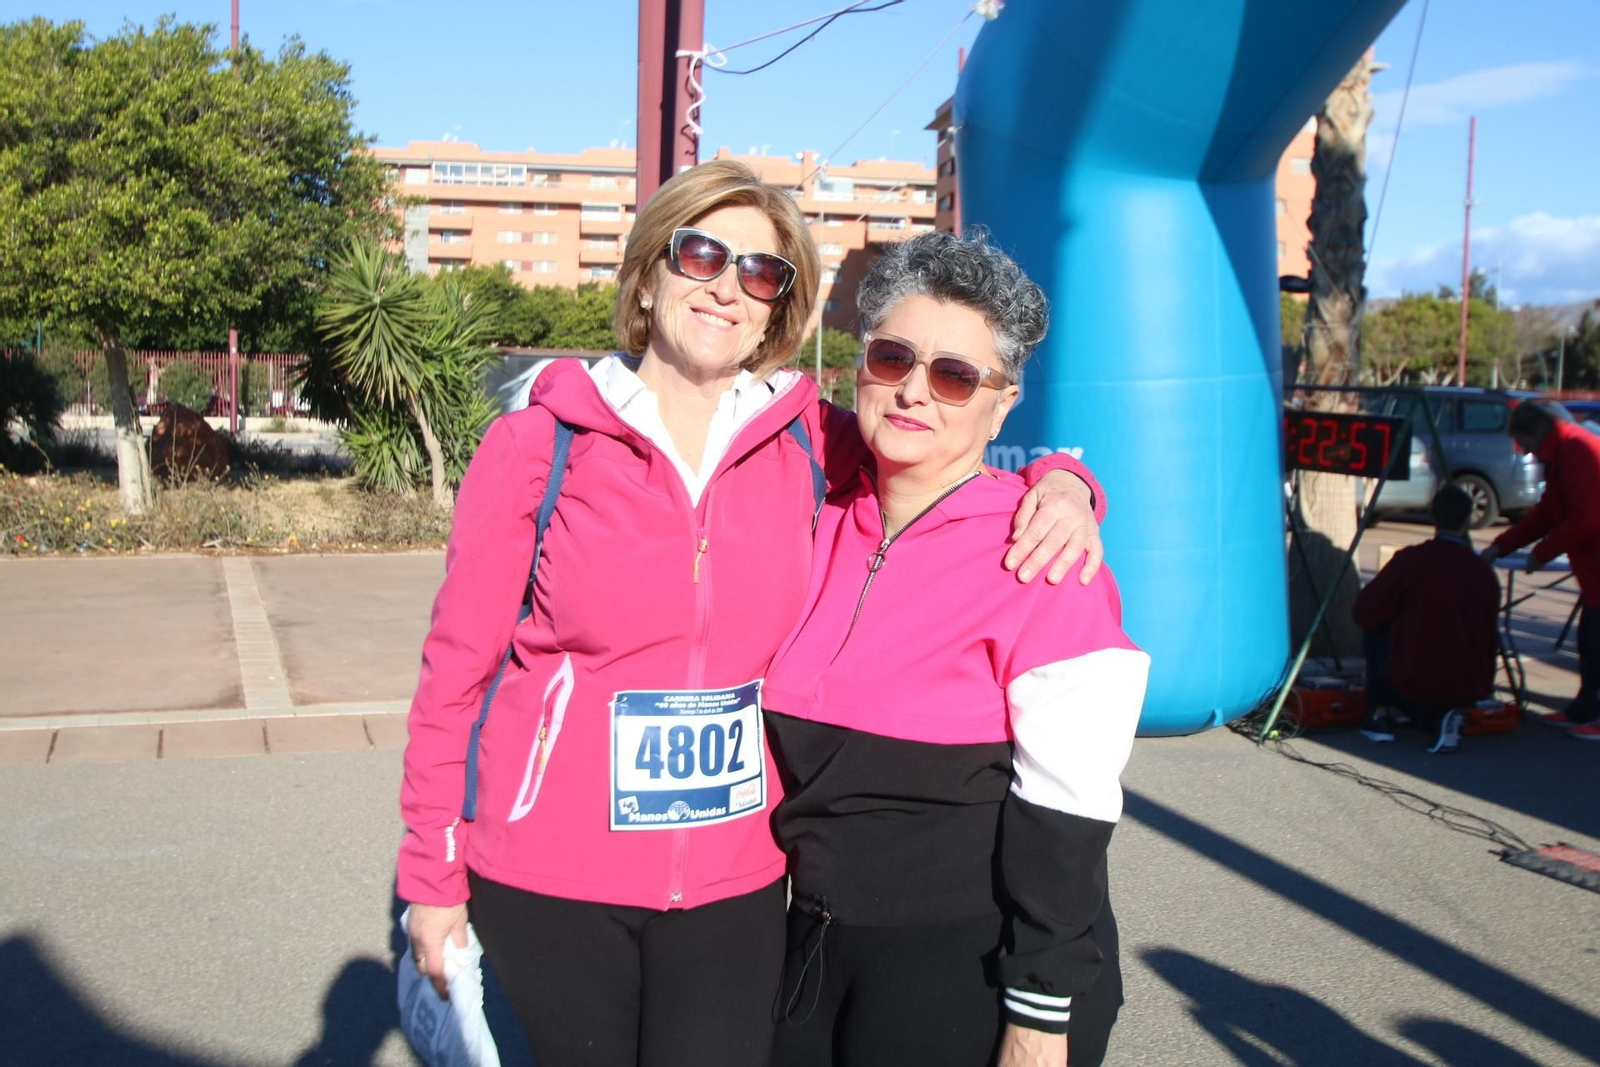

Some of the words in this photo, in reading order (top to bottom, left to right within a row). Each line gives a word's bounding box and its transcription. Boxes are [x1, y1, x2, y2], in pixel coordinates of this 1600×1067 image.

[635, 718, 745, 779] 4802
[628, 811, 668, 823] Manos
[690, 806, 726, 820] Unidas
